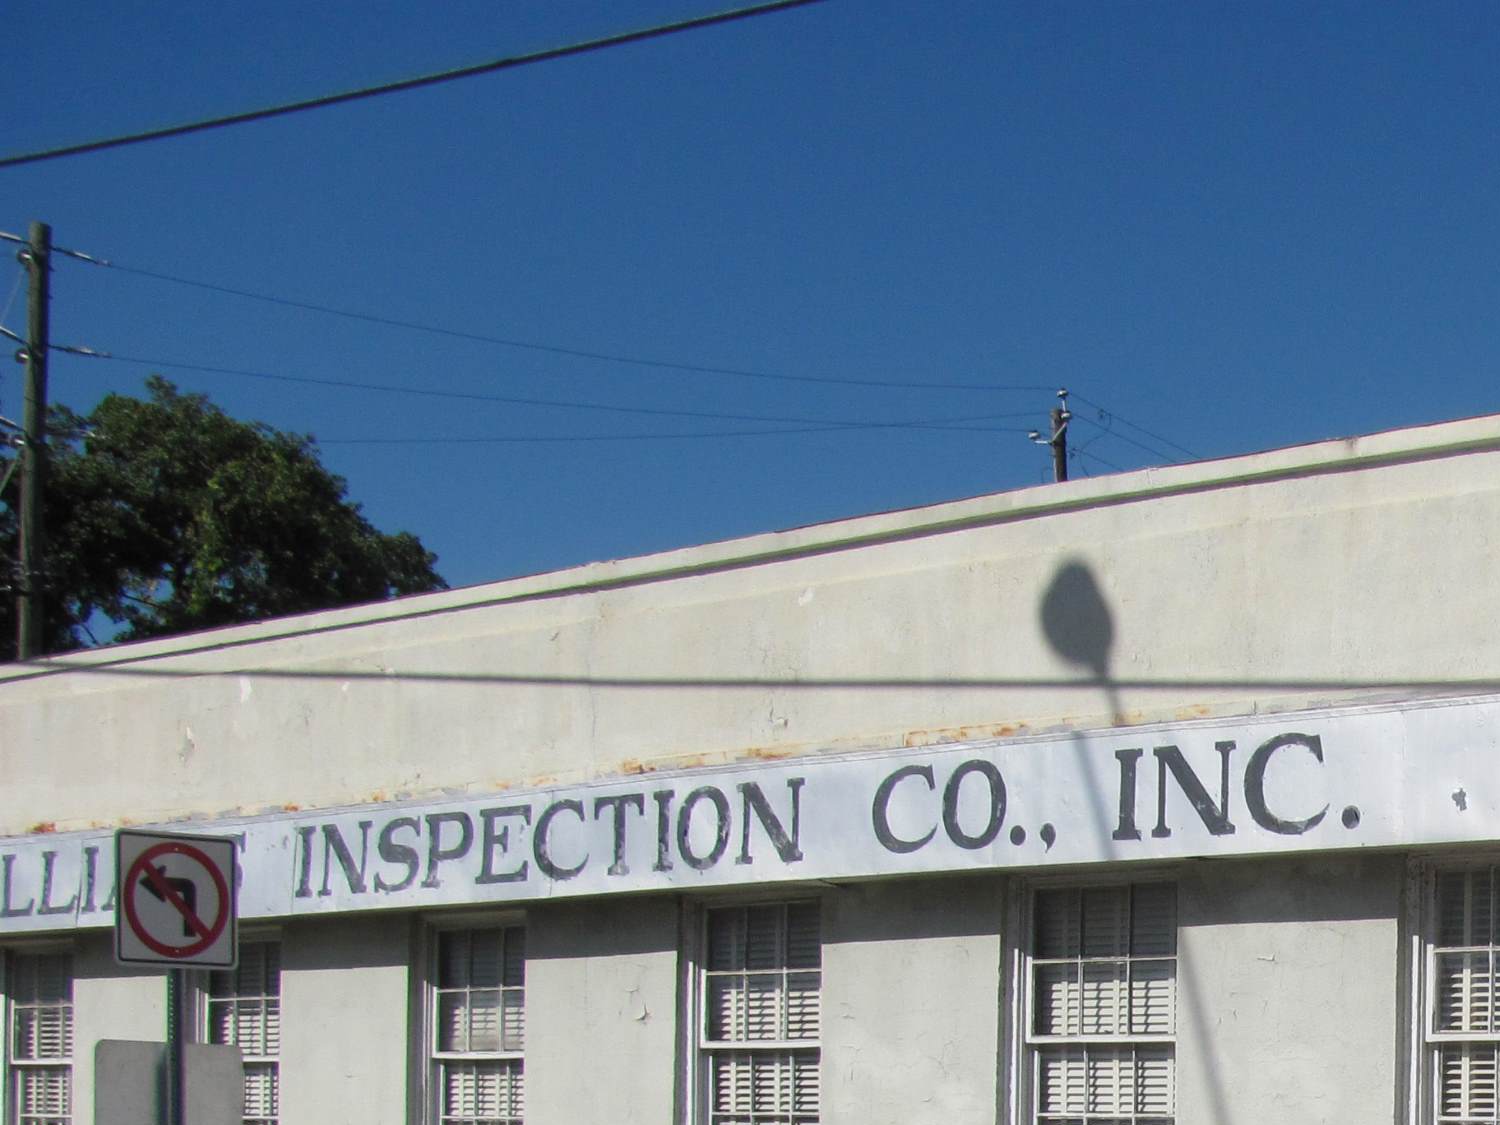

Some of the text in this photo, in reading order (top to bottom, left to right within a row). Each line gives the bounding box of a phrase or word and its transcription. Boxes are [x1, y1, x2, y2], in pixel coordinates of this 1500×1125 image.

[295, 777, 805, 898] INSPECTION
[871, 758, 1057, 853] CO.,
[1112, 732, 1361, 841] INC.
